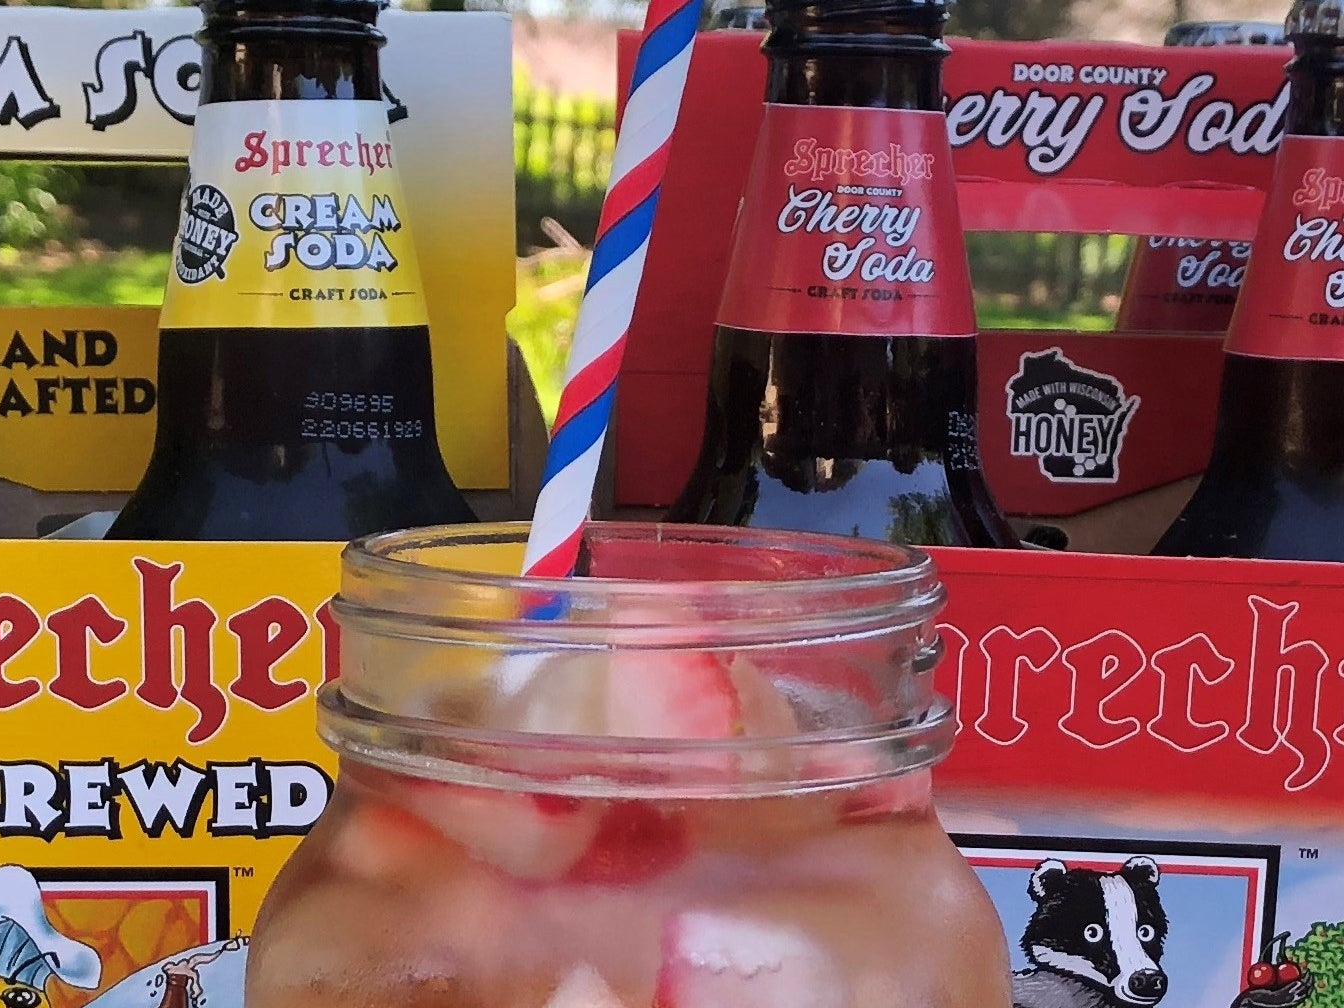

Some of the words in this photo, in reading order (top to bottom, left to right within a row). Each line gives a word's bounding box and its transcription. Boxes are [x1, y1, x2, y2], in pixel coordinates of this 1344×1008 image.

[1013, 63, 1074, 83] DOOR
[1079, 65, 1168, 86] COUNTY
[944, 87, 1106, 175] erry
[1118, 73, 1292, 154] Sod
[784, 138, 935, 186] Sprecher
[192, 187, 229, 218] MADE
[837, 185, 864, 195] DOOR
[866, 187, 903, 198] COUNTY
[248, 192, 402, 235] CREAM
[777, 184, 921, 248] Cherry
[264, 231, 399, 273] SODA
[822, 237, 935, 283] Soda
[289, 288, 345, 301] CRAFT
[349, 287, 388, 301] SODA
[807, 286, 858, 300] CRAFT
[862, 287, 903, 301] SODA
[1015, 386, 1042, 410] MADE
[1042, 381, 1067, 395] WITH
[1011, 413, 1117, 457] HONEY
[1298, 847, 1319, 859] TM
[232, 866, 254, 877] TM
